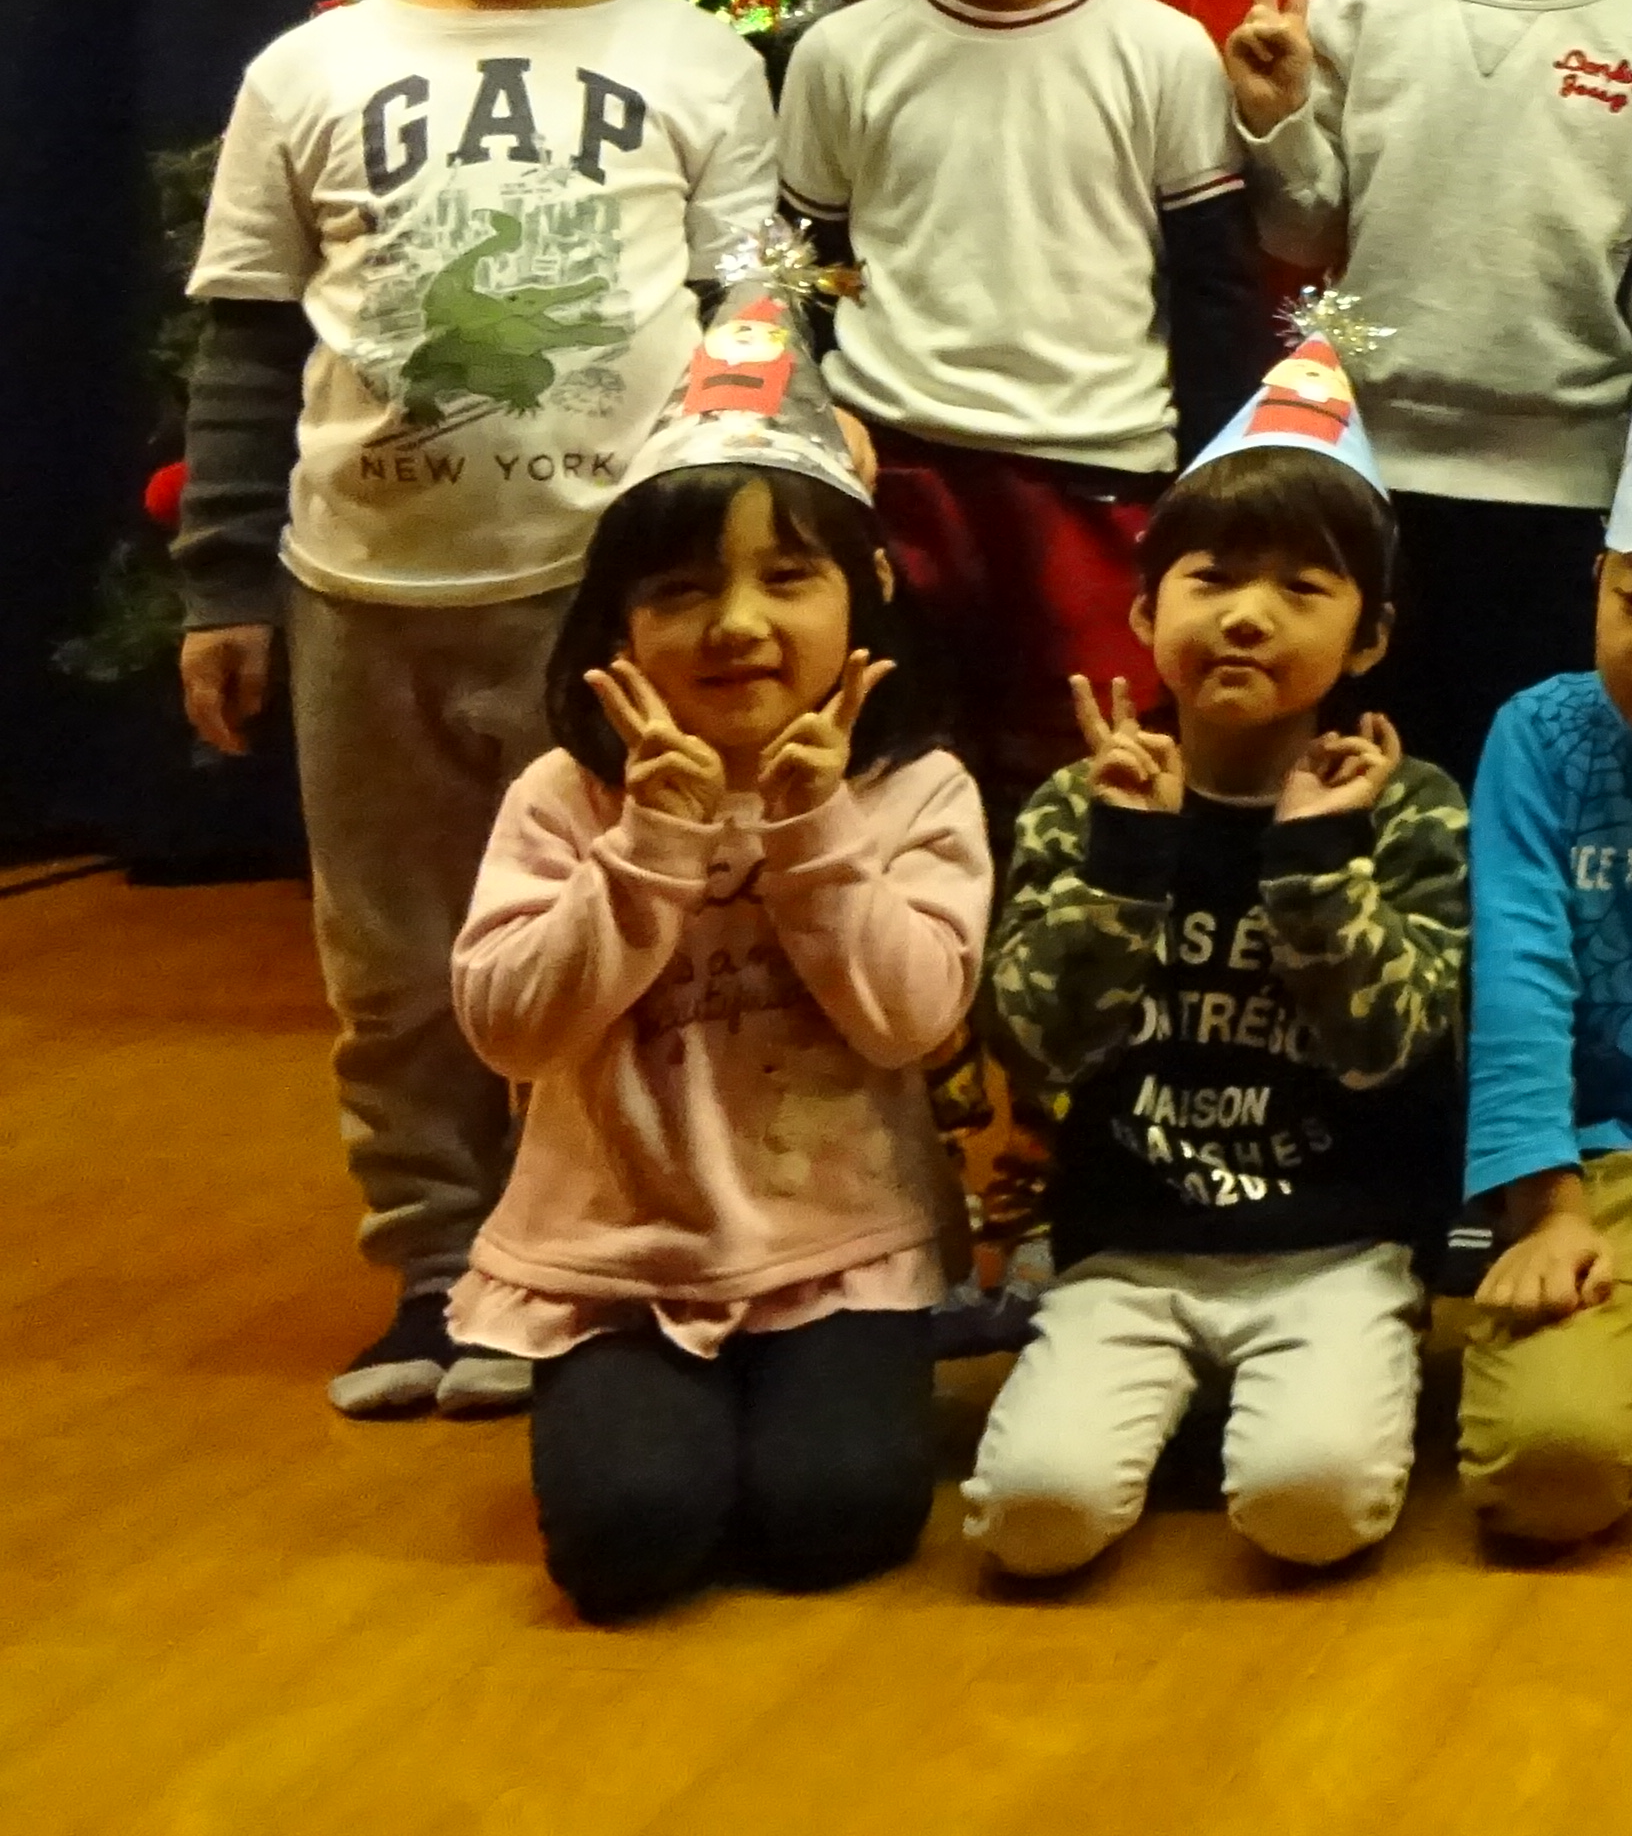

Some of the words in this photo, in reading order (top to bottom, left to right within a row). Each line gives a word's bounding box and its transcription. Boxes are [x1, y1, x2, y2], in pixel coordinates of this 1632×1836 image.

[362, 57, 647, 197] GAP
[360, 451, 463, 486] NEW
[494, 449, 622, 484] YORK
